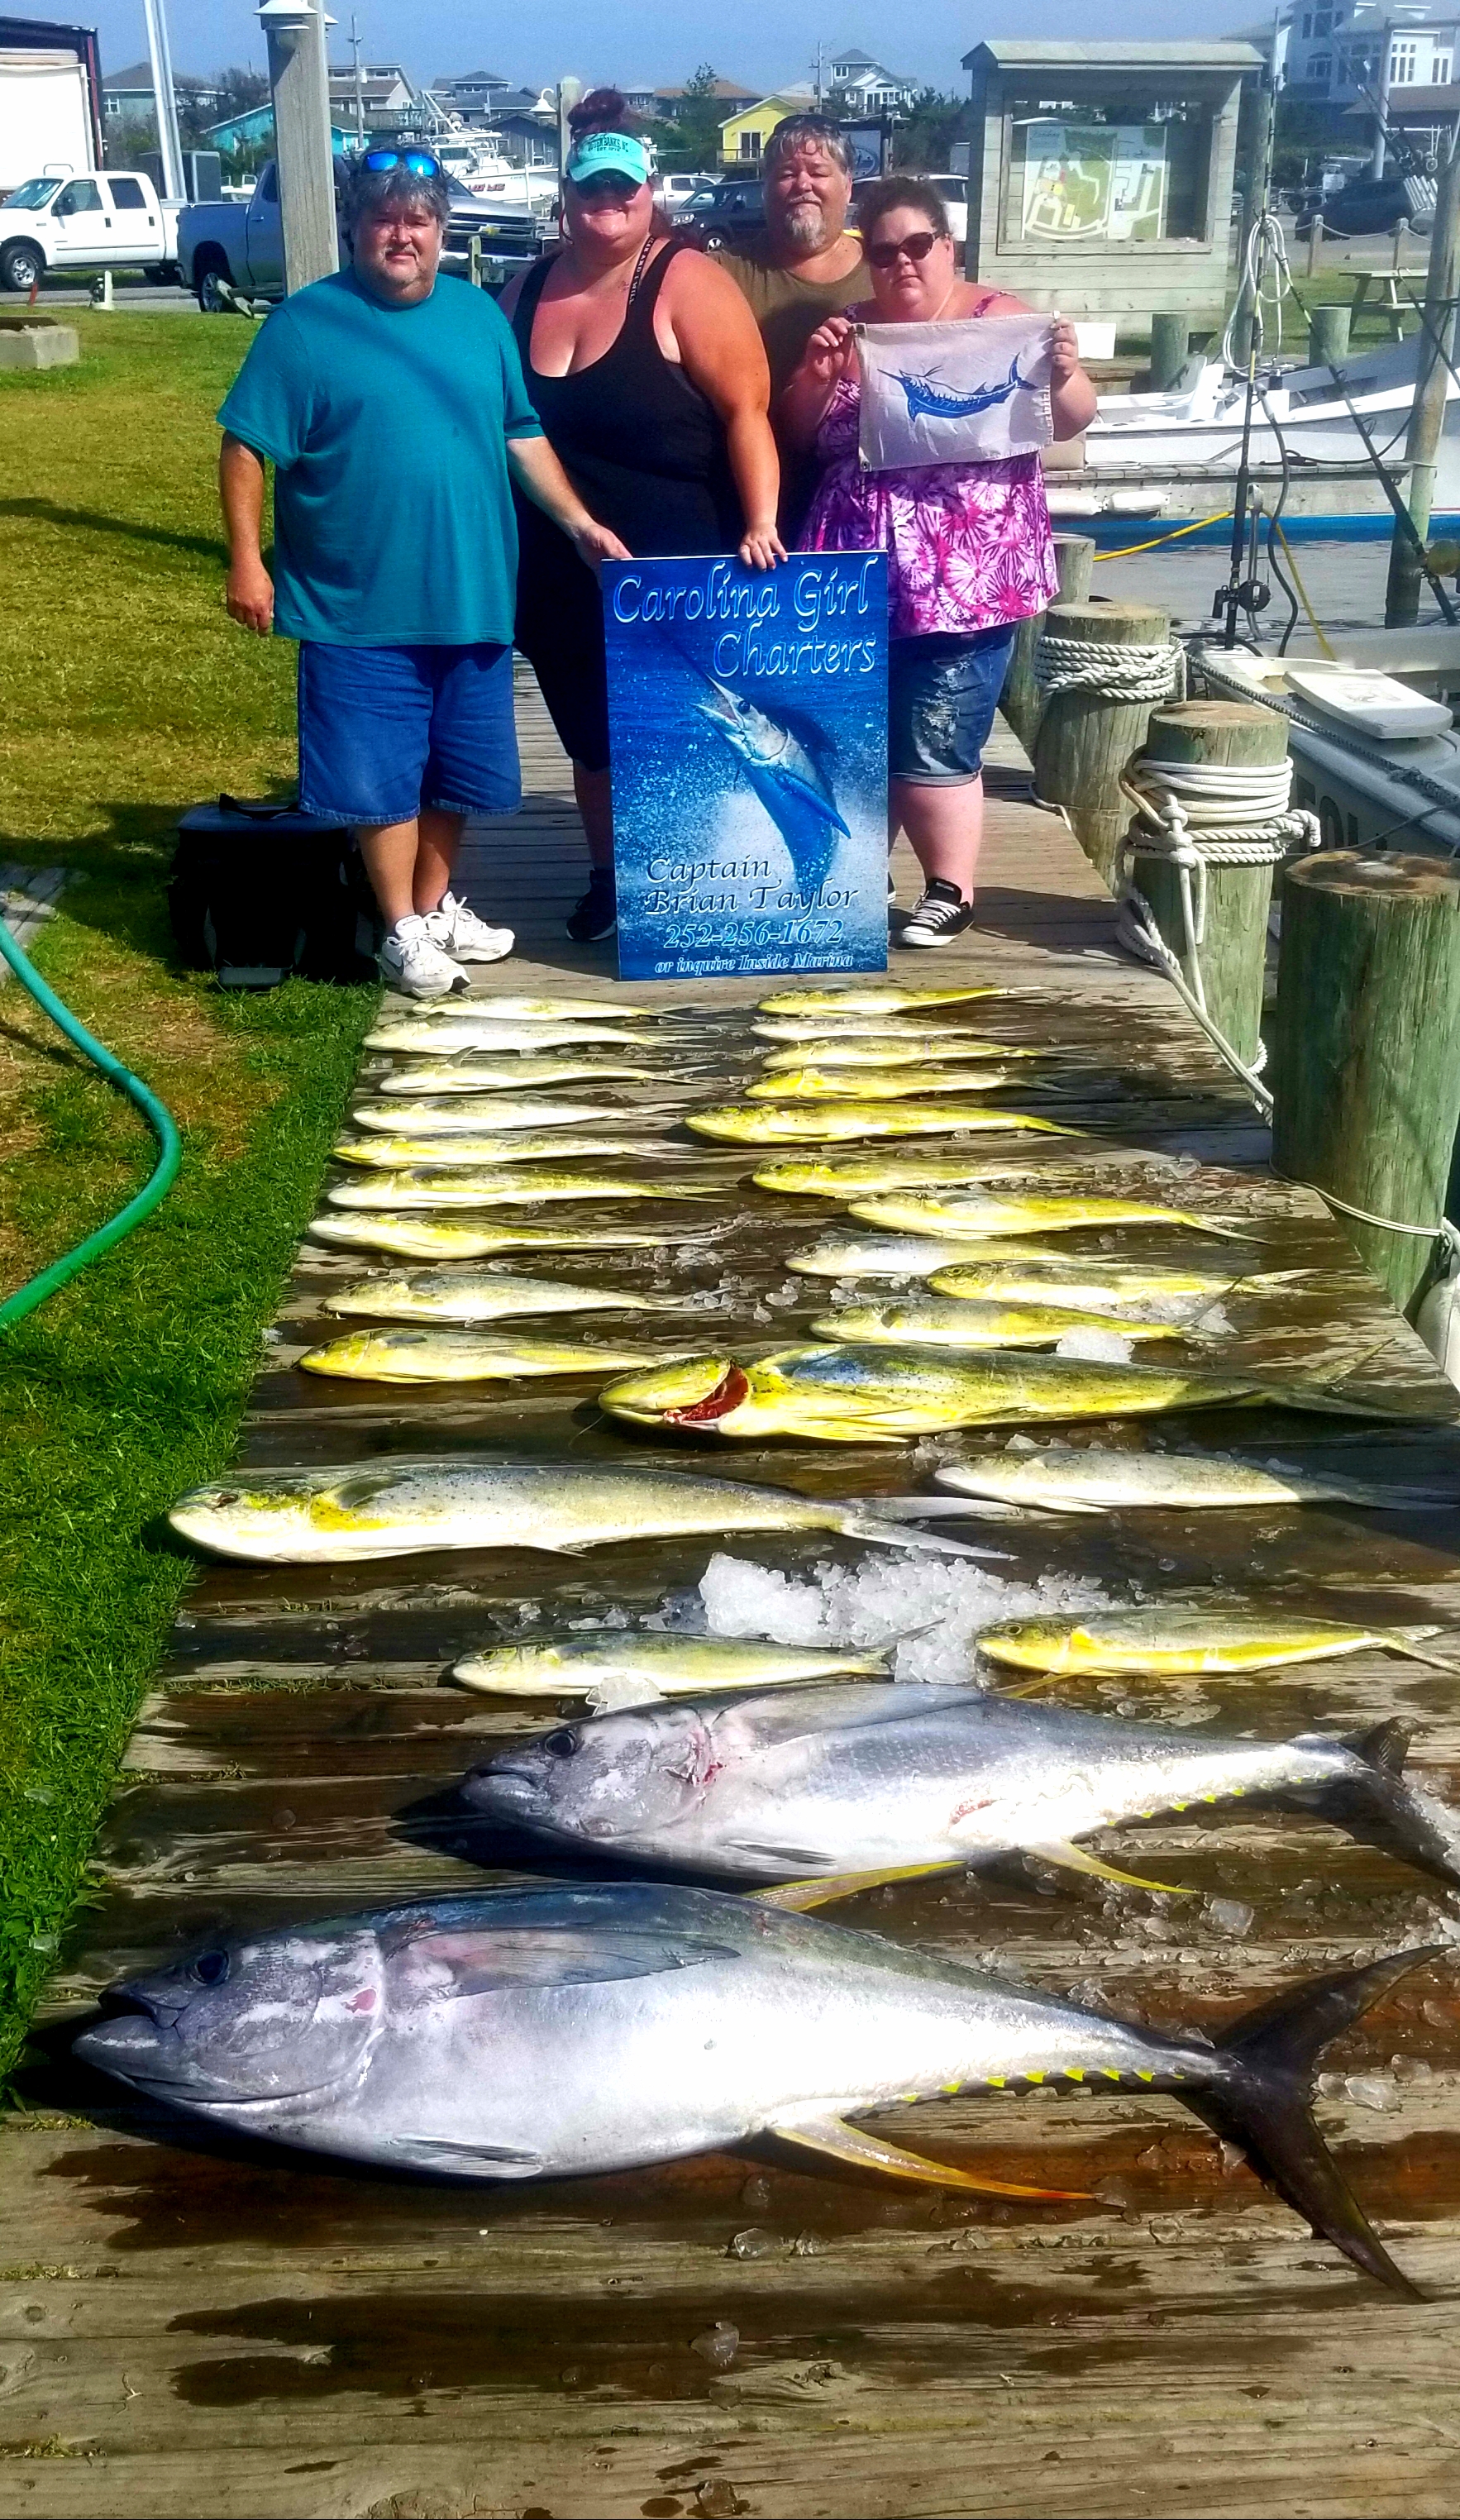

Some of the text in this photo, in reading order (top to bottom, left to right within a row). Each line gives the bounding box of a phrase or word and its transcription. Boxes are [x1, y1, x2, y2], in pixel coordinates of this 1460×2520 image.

[644, 241, 653, 252] CAN
[637, 255, 646, 272] AND
[629, 282, 637, 304] WILL
[613, 556, 879, 632] Carolina Girl
[713, 618, 876, 678] Charters
[645, 855, 772, 895] Captain
[644, 878, 860, 922] Brian Taylor
[663, 919, 844, 949] 252-256-1672
[655, 952, 853, 976] or inquire Inside Marina
